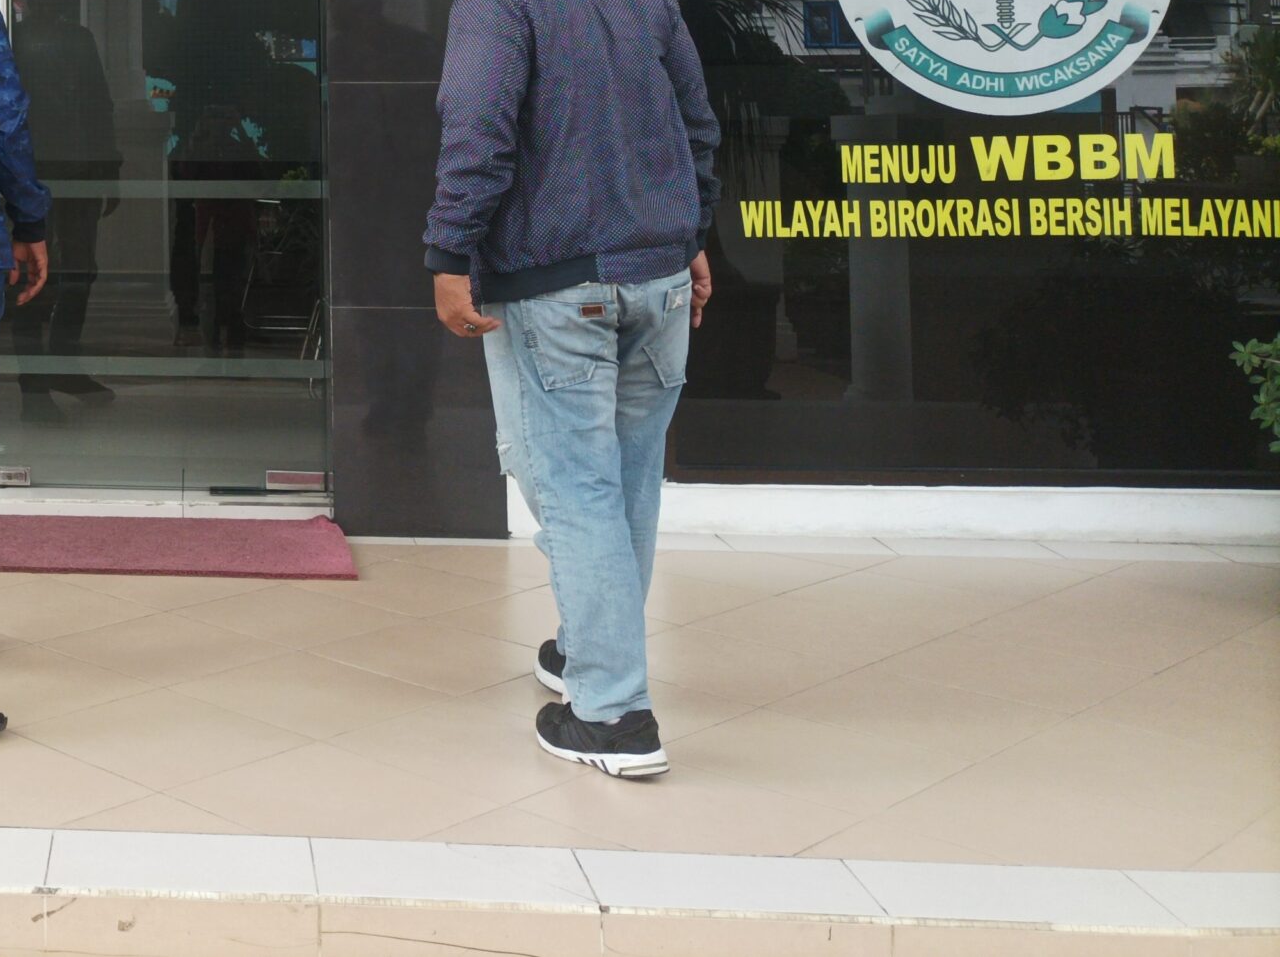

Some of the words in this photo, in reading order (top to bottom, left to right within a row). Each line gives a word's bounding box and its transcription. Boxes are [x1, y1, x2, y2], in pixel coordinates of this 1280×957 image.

[894, 37, 949, 81] SATYA
[956, 74, 1005, 92] ADHI
[1015, 32, 1125, 91] WICAKSANA
[841, 144, 957, 185] MENUJU
[970, 132, 1177, 183] WBBM
[740, 199, 861, 239] WILAYAH
[868, 197, 1022, 239] BIROKRASI
[1029, 197, 1134, 238] BERSIH
[1140, 197, 1280, 239] MELAYANI
